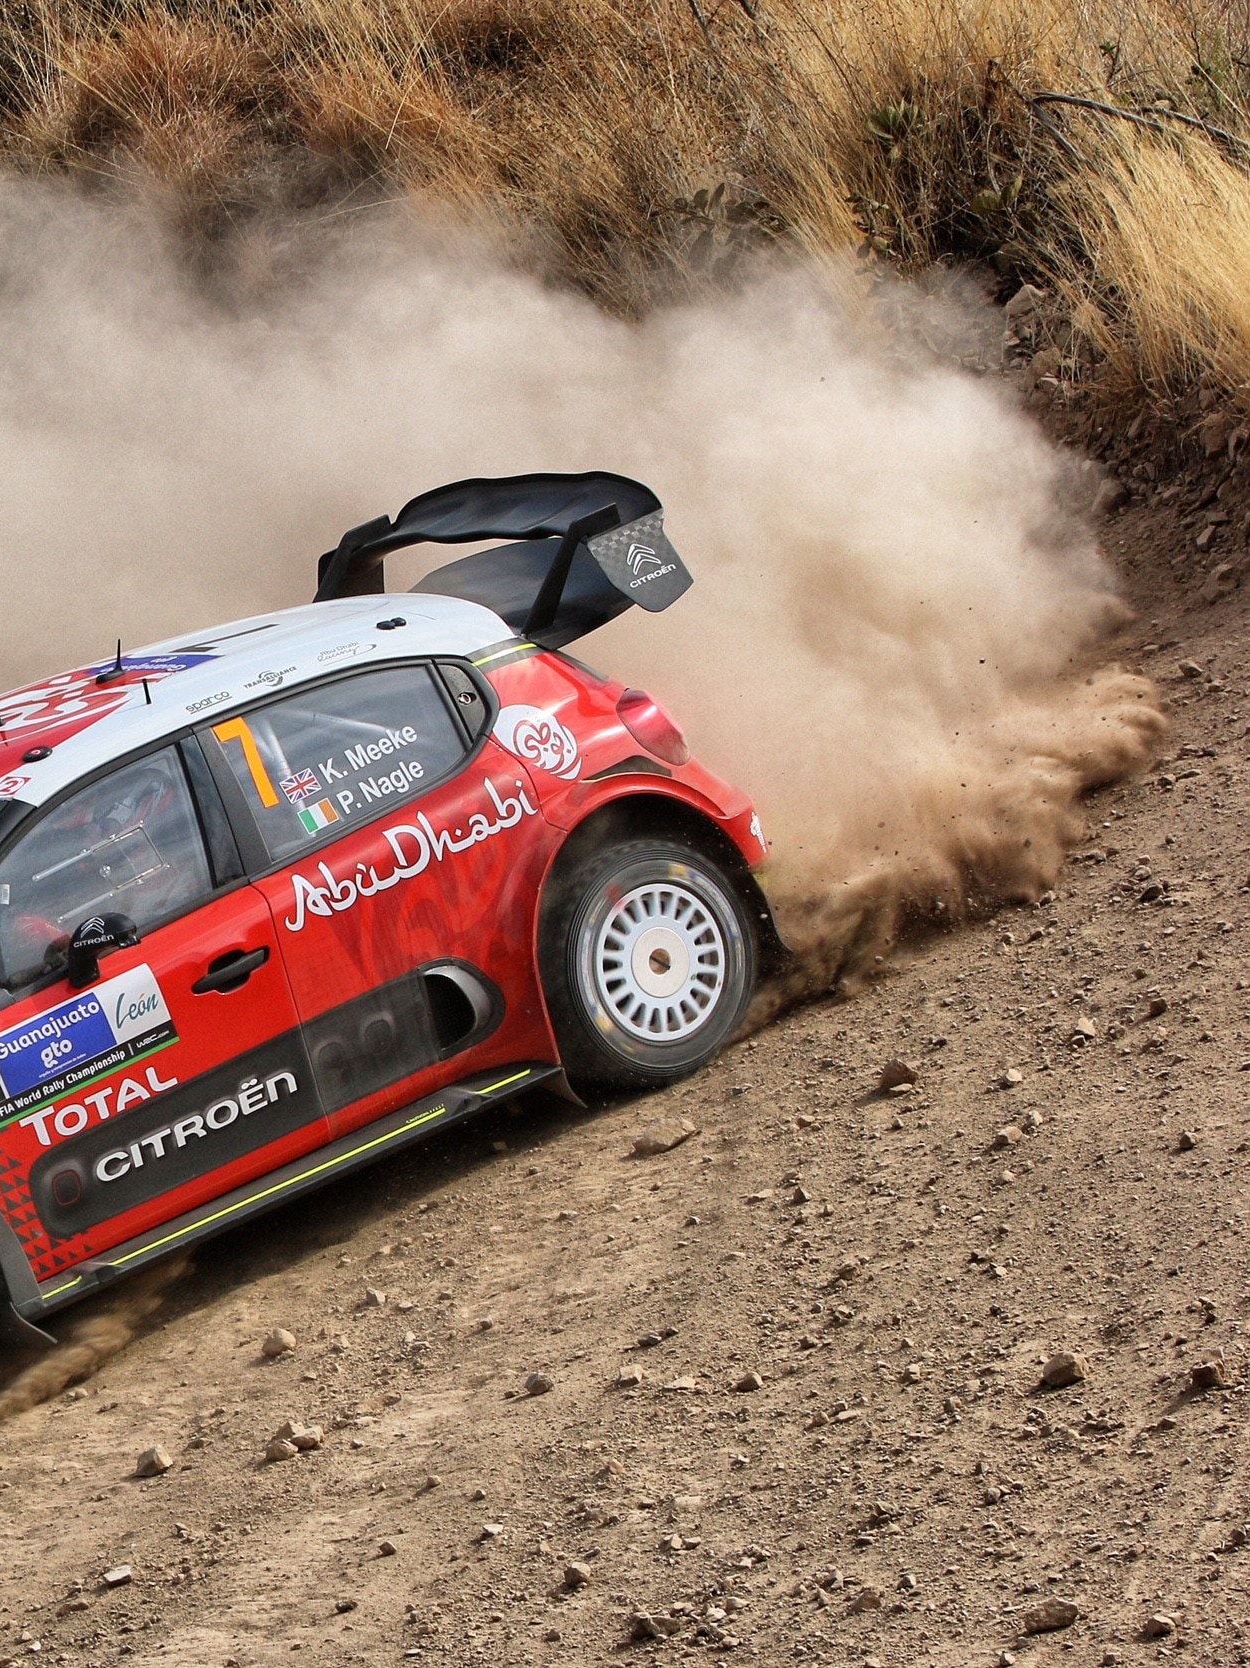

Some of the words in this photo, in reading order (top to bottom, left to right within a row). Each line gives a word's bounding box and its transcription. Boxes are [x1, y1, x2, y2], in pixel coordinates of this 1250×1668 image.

[185, 690, 230, 714] sparco
[211, 717, 279, 808] 7
[317, 758, 347, 784] K.
[344, 724, 418, 771] Meeke
[339, 791, 362, 815] P.
[361, 758, 424, 804] Nagle
[116, 992, 159, 1030] León
[14, 1089, 42, 1109] World
[42, 1079, 66, 1096] Rally
[66, 1050, 126, 1084] Championship
[40, 1039, 73, 1069] gto
[19, 1066, 178, 1146] TOTAL
